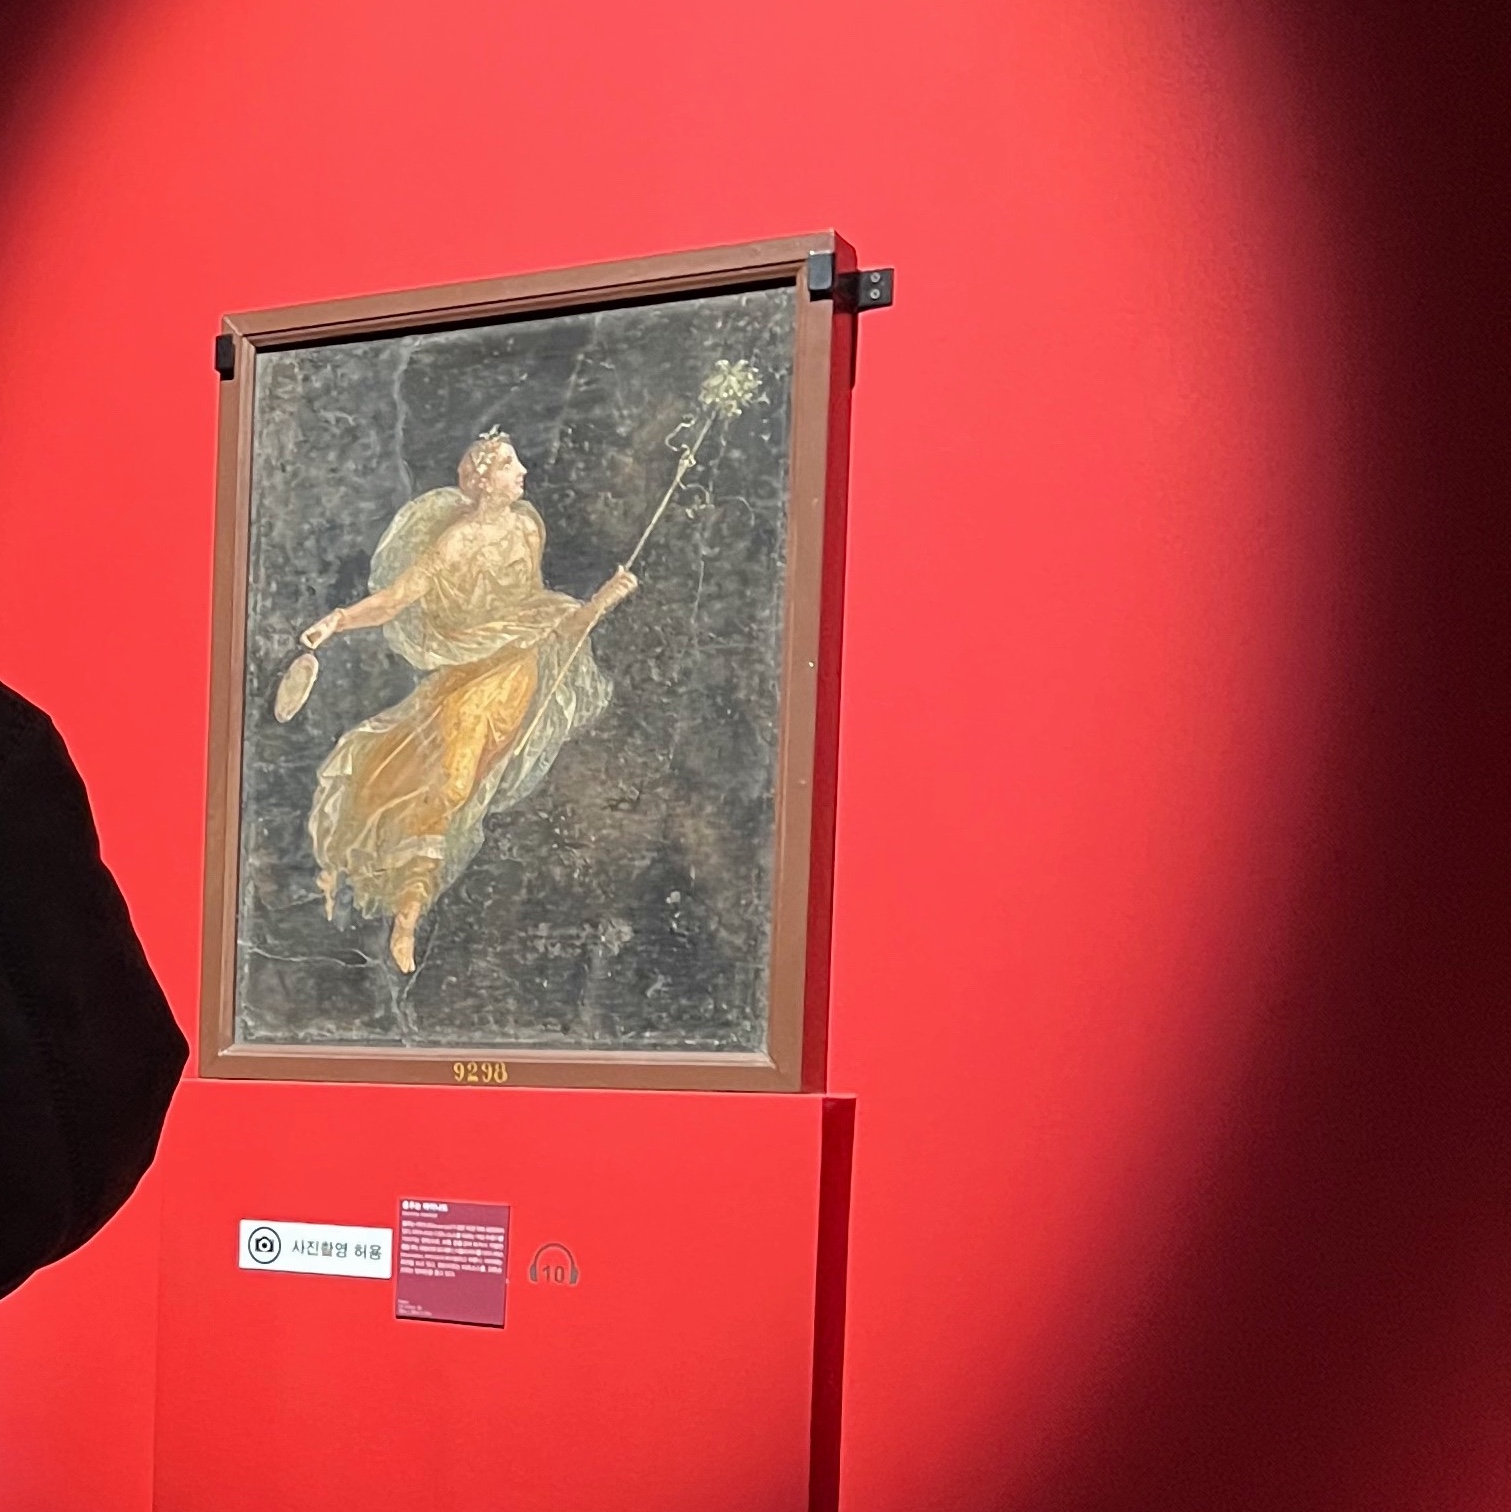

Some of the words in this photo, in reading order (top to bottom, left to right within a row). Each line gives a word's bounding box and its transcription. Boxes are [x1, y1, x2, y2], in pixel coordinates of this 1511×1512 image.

[453, 1061, 508, 1084] 9298
[291, 1239, 348, 1259] 사진촬영
[354, 1244, 382, 1261] 허용
[542, 1265, 565, 1283] 10
